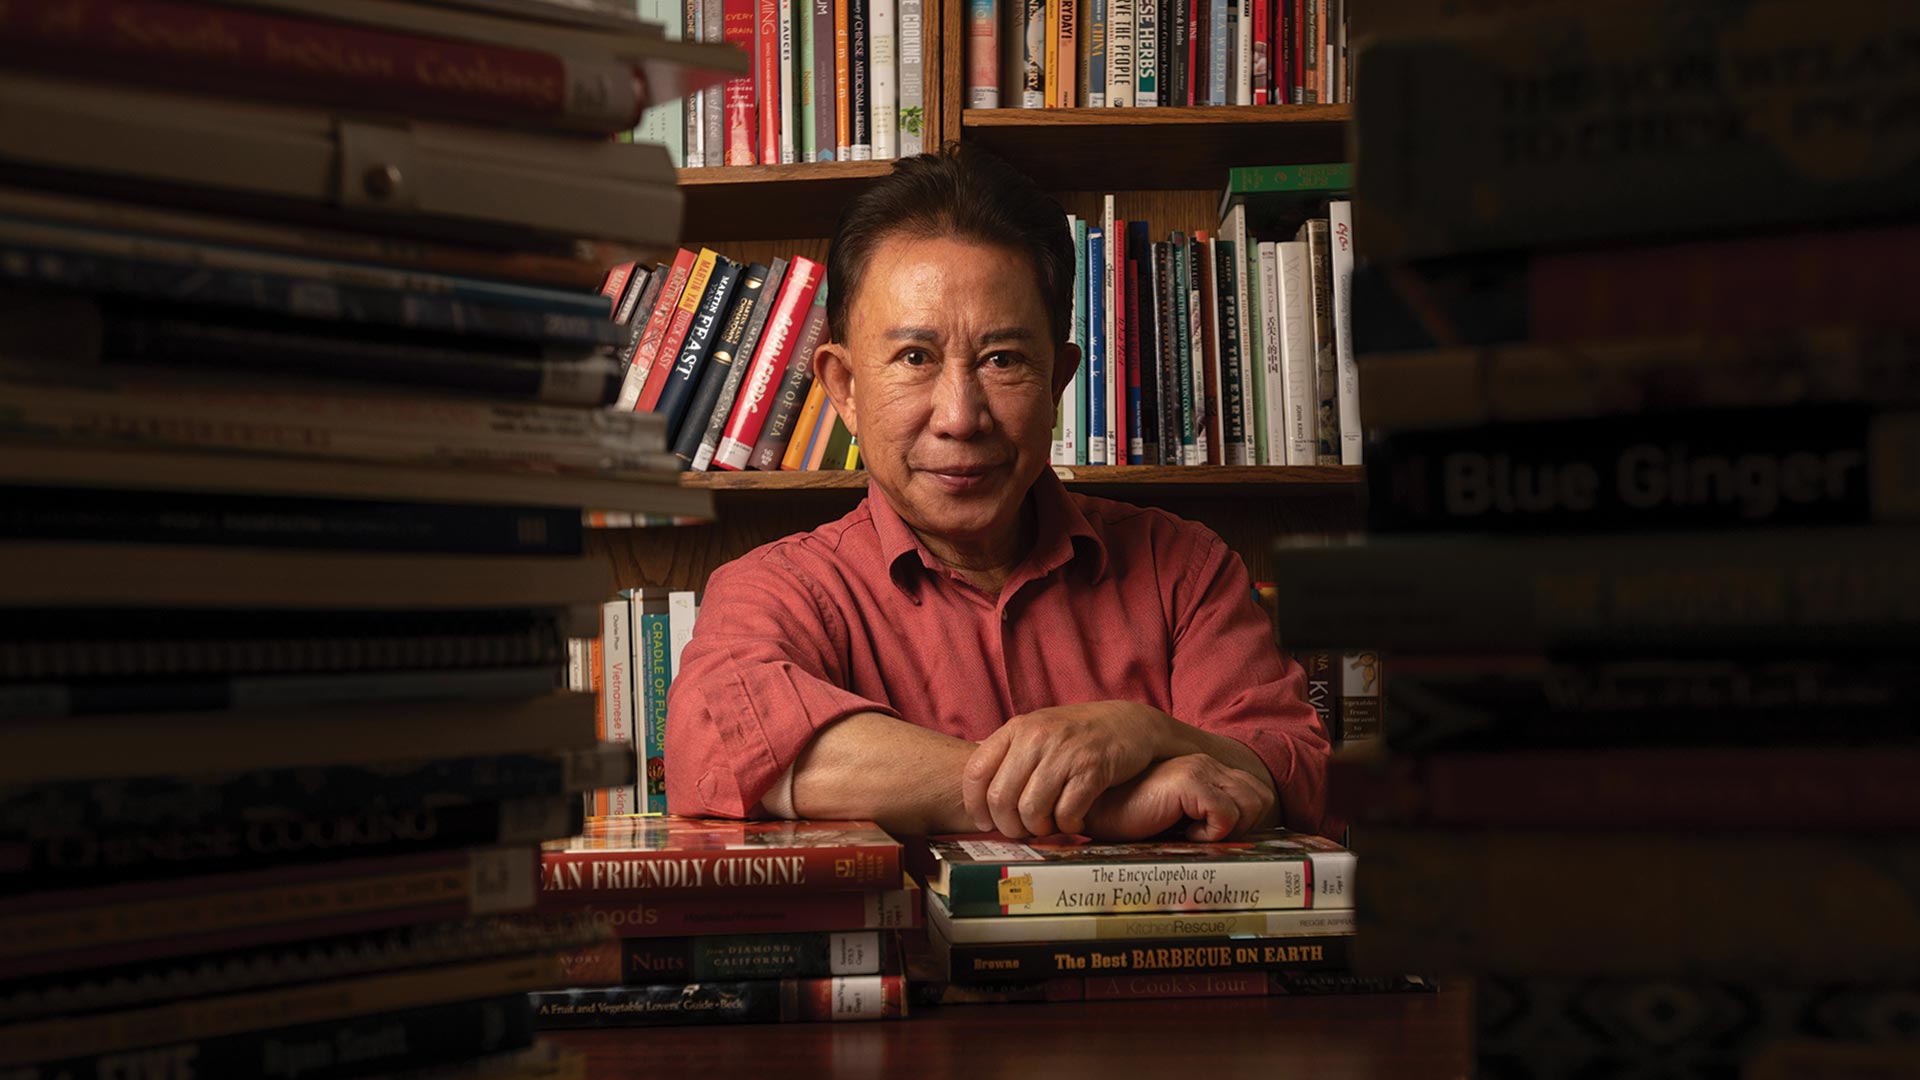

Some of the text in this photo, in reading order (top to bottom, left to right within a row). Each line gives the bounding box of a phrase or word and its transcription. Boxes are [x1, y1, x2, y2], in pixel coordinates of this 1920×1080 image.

[725, 13, 754, 21] EVERY
[726, 27, 753, 35] GRAIN
[1115, 22, 1131, 40] THE
[1175, 26, 1185, 46] Herbs
[782, 20, 790, 60] SAUCES
[902, 14, 920, 64] COOKING
[1091, 23, 1104, 57] CHINA
[1139, 27, 1157, 78] HERBS
[1216, 6, 1226, 93] TEA WISDOM
[854, 21, 866, 138] CHINESE MEDICINAL HERBS
[1114, 46, 1131, 85] PEOPLE
[682, 259, 711, 309] MARTIN YAN
[709, 275, 731, 314] MARTIN
[658, 309, 695, 371] QUICK & EASY
[676, 312, 714, 381] FEAST
[737, 326, 758, 367] MARTIN
[770, 318, 825, 437] THE STORY OF TEA
[1226, 296, 1241, 437] FROM THE EARTH
[1182, 398, 1193, 438] COOKBOOK
[1442, 443, 1862, 520] Blue Ginger
[612, 662, 625, 729] Vietnamese
[652, 621, 667, 752] CRADLE OF FLAVOR
[591, 858, 707, 890] FRIENDLY
[713, 855, 806, 888] CUISINE
[1092, 865, 1217, 886] The Encyclopedia of
[1055, 882, 1260, 908] Asian Food and Cooking
[631, 952, 685, 972] Nuts
[713, 955, 796, 967] CALIFORNIA
[728, 944, 791, 955] DIAMOND
[973, 945, 1324, 970] Browne The Best BARBECUE ON EARTH
[1105, 974, 1249, 995] A Cook's Tour
[540, 998, 745, 1017] A Fruit and Vegetable Lovers' Guide Beck
